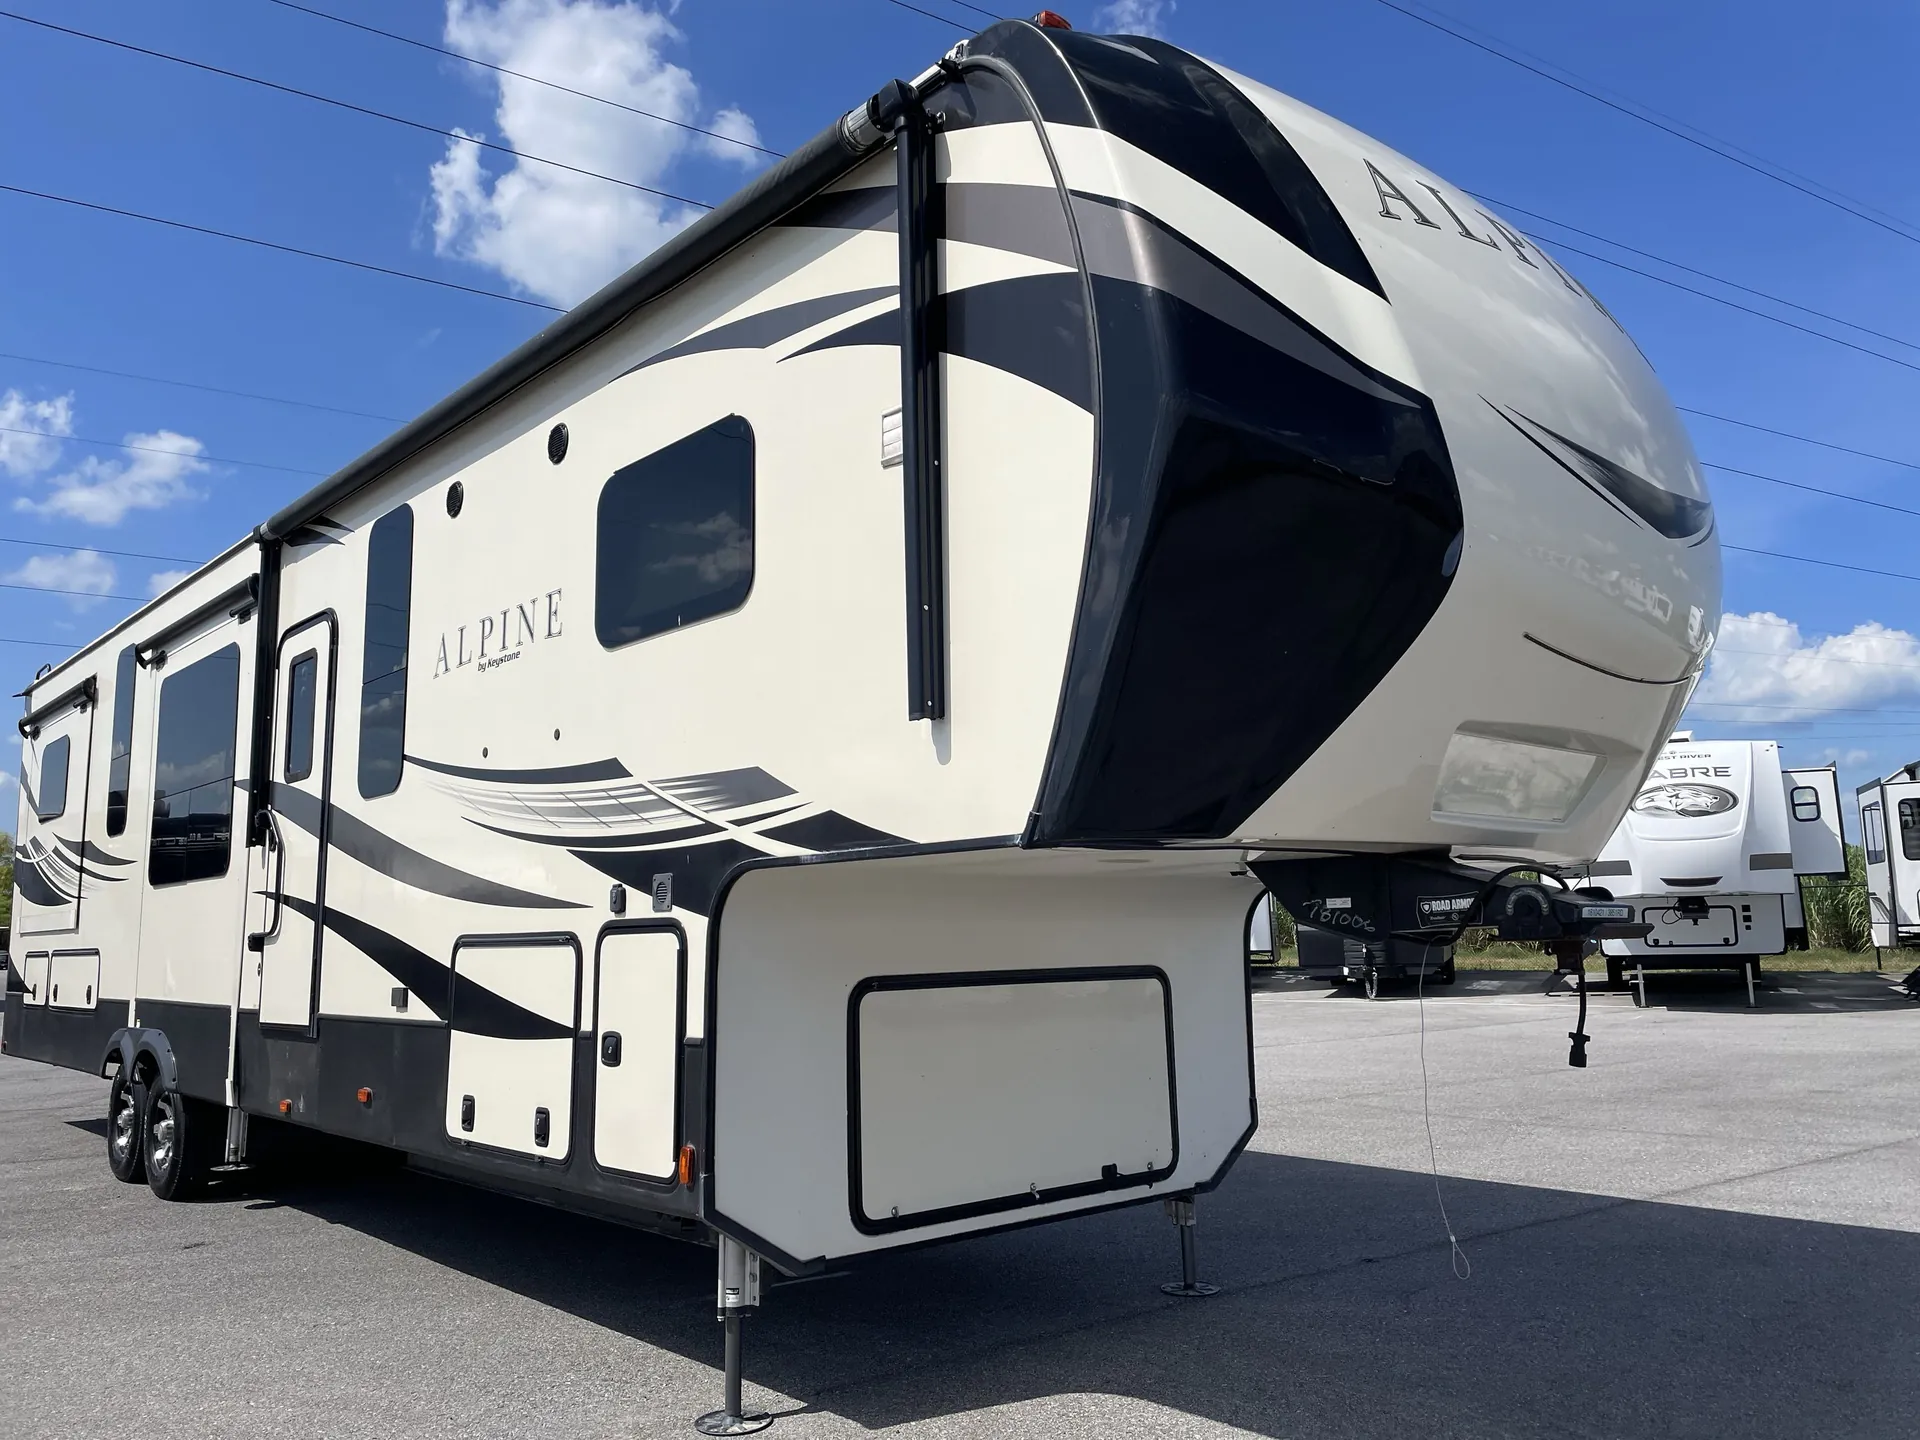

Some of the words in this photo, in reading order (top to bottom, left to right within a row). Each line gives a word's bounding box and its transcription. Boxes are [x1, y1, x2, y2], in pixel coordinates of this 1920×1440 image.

[1362, 157, 1656, 373] ALPI
[432, 587, 563, 680] ALPINE
[477, 661, 487, 673] by
[487, 650, 521, 669] Keystone
[1648, 766, 1733, 781] ABRE
[1432, 899, 1451, 911] ROAD
